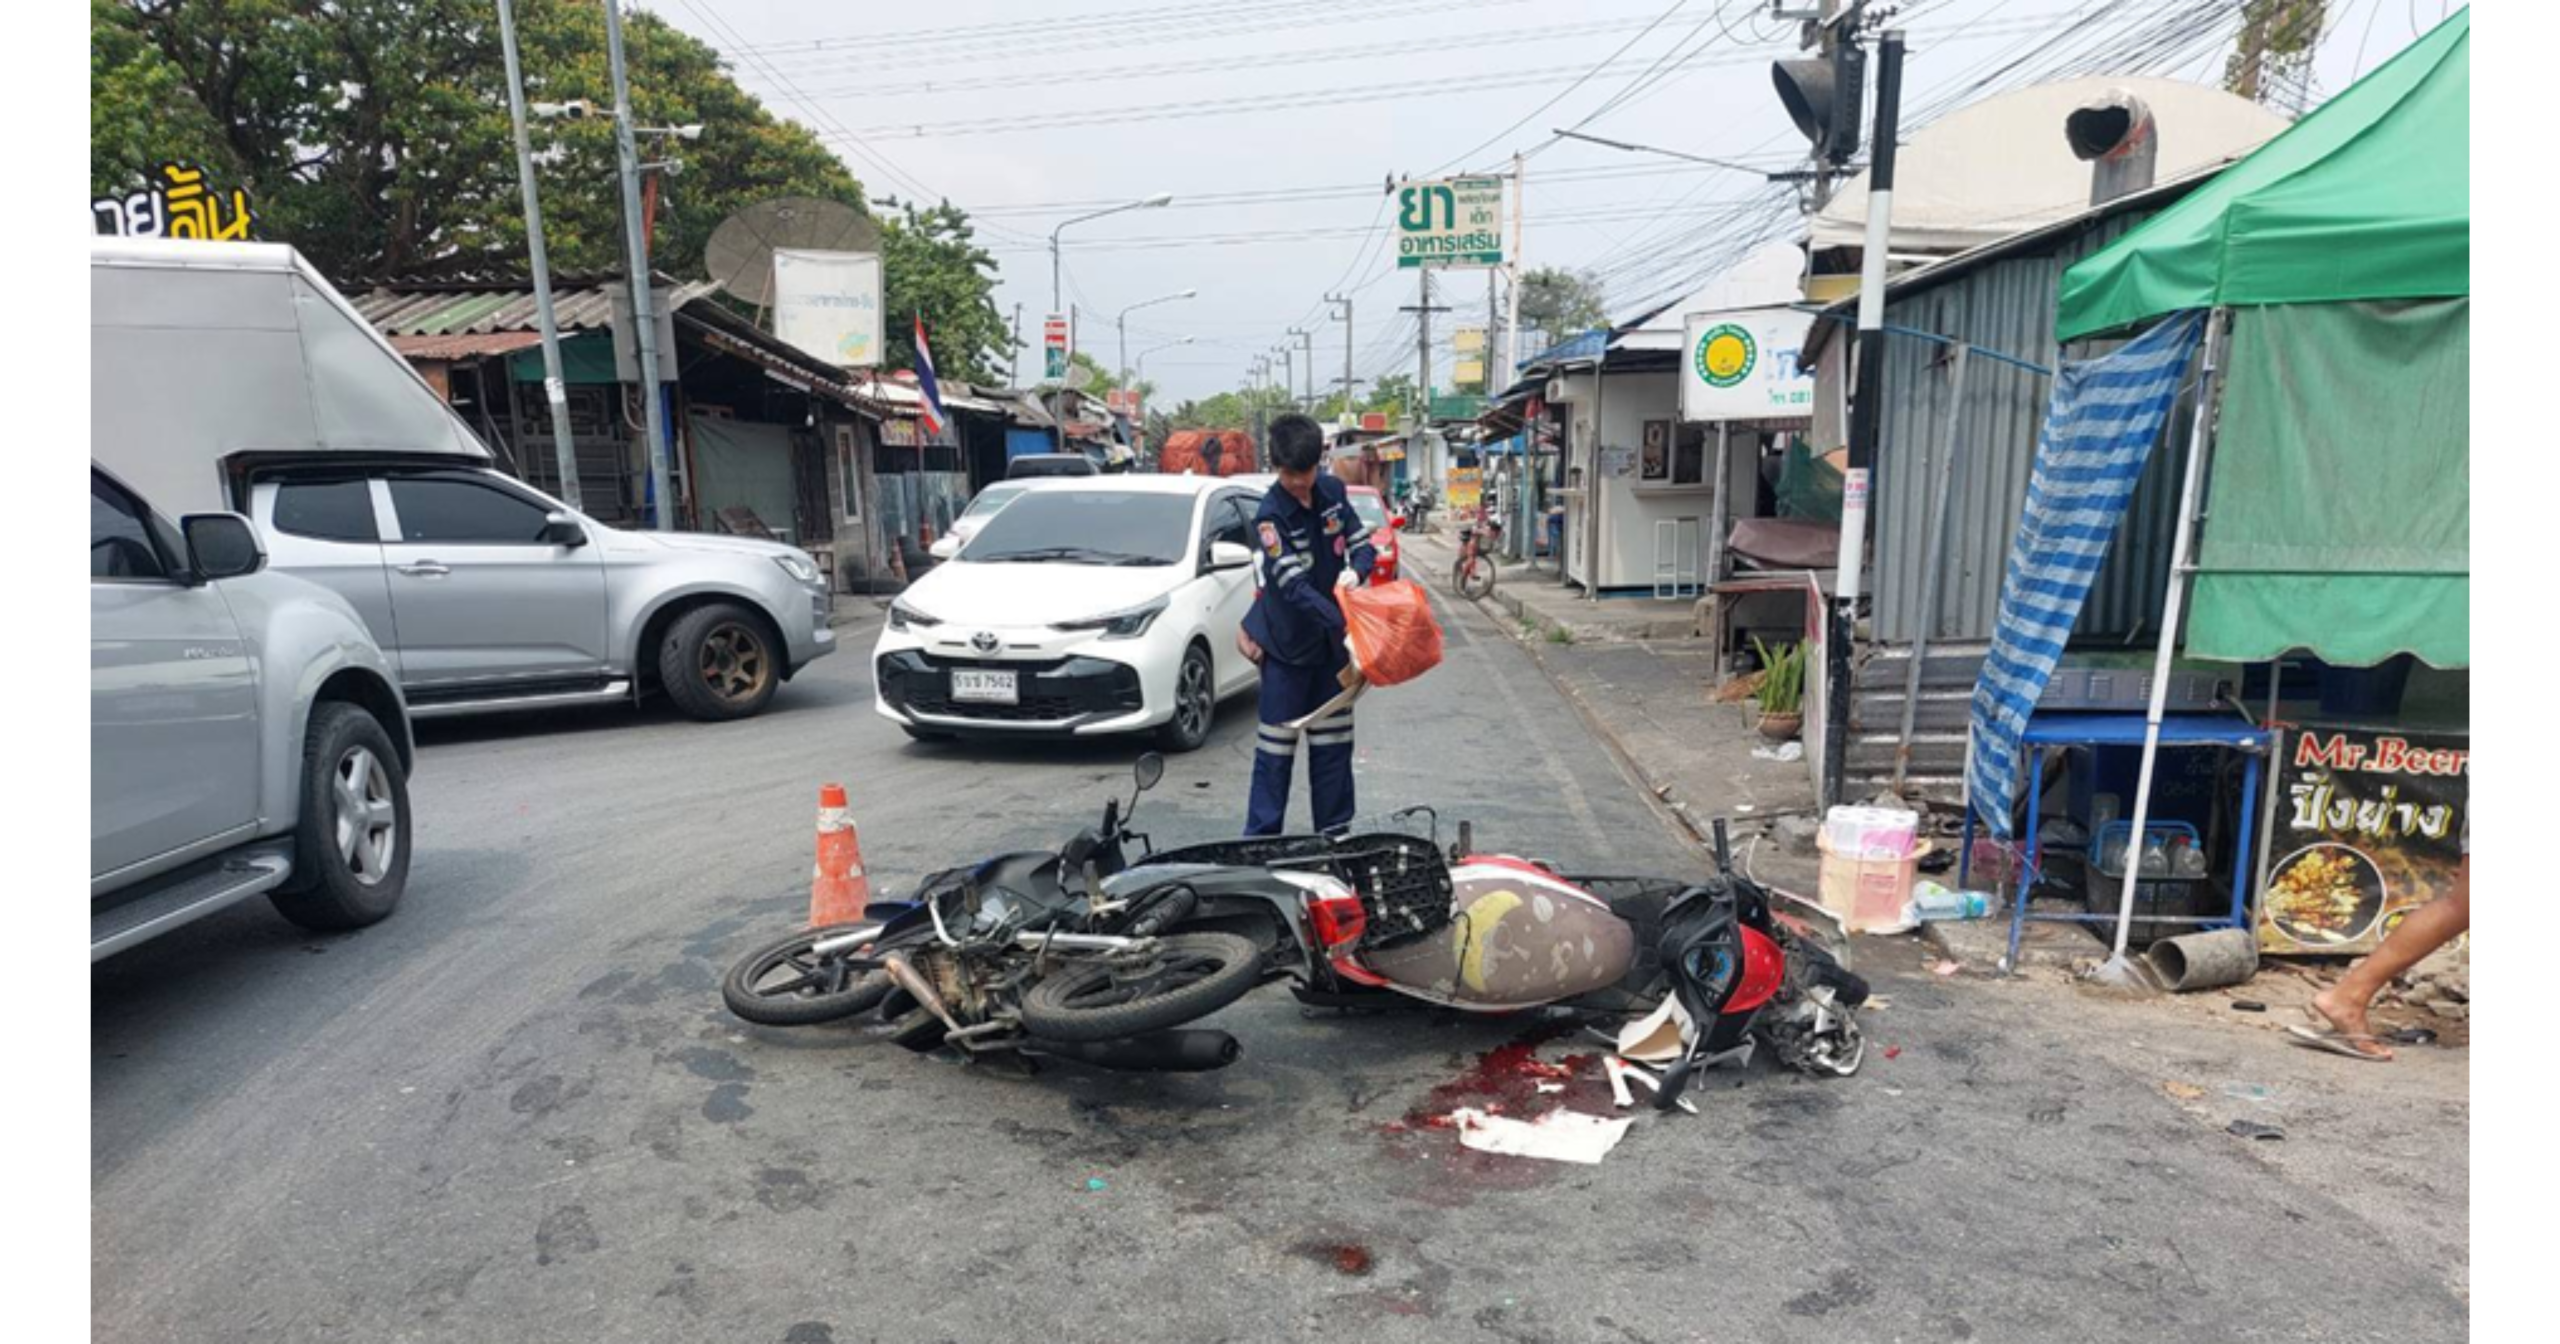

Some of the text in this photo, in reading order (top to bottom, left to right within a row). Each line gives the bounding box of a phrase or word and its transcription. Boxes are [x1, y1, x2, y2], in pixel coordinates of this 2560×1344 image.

[1399, 185, 1454, 232] ยา
[1469, 205, 1493, 225] เด็ก
[1401, 228, 1501, 254] อาหารเสริม
